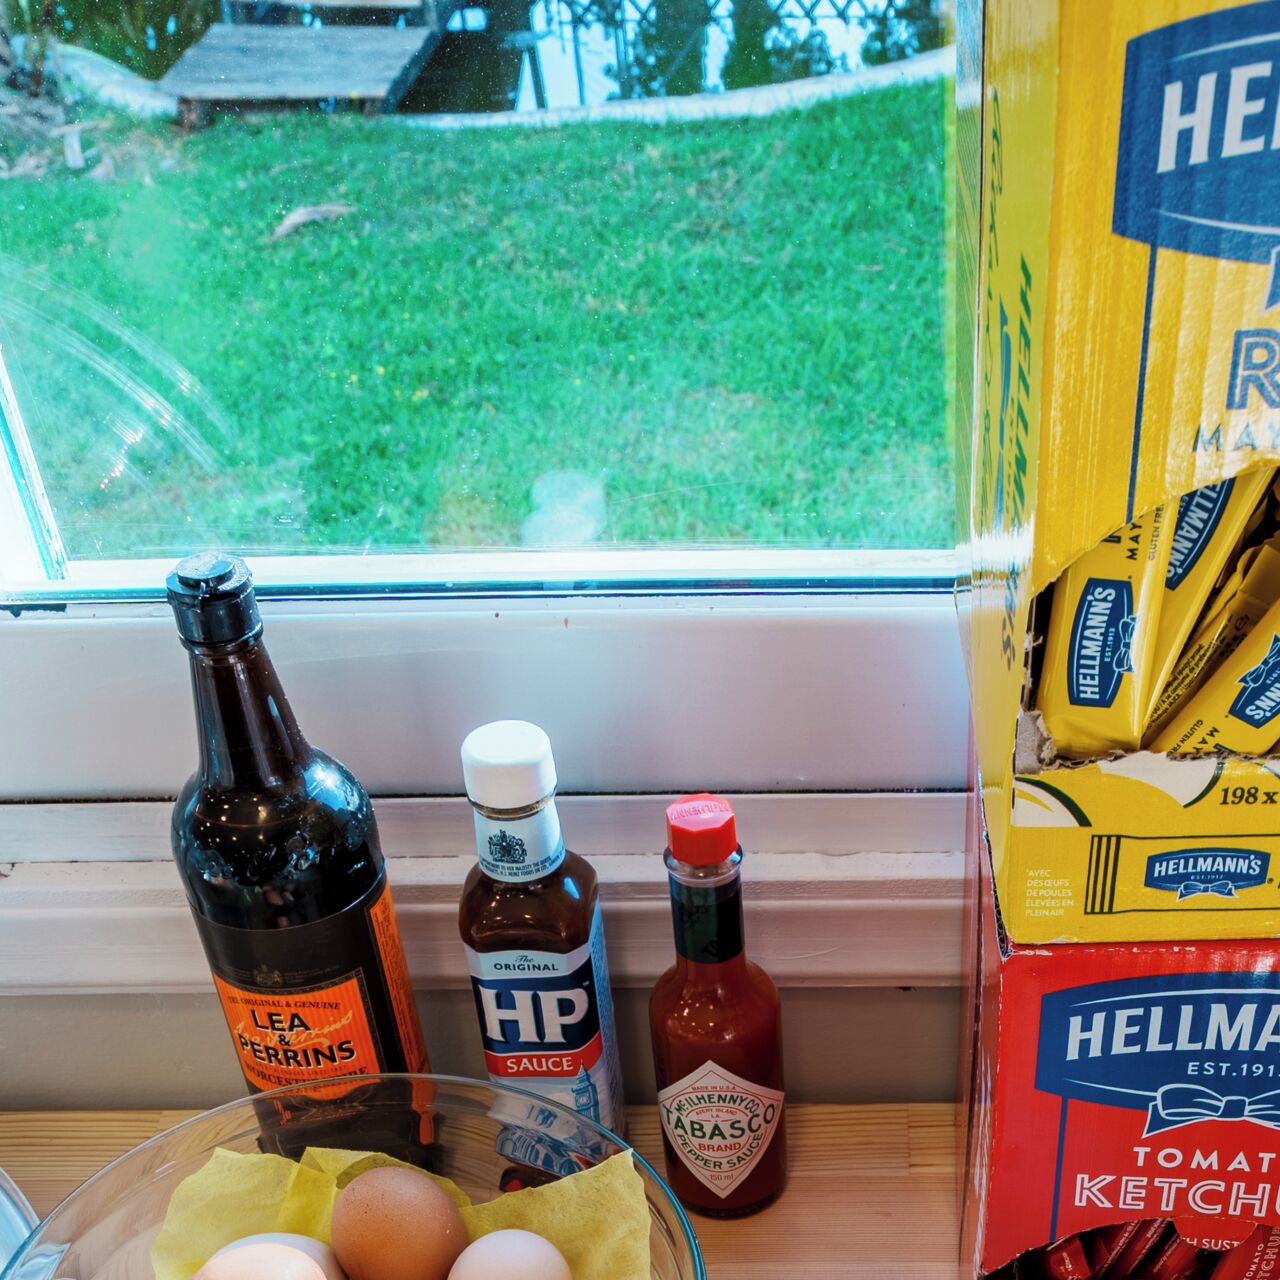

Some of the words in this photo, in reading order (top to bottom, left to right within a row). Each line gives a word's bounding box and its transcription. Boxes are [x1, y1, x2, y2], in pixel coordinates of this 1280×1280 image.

[1165, 481, 1220, 579] ELLMANN'S
[1078, 586, 1116, 700] HELLMANN'S
[1182, 719, 1204, 744] GLUTEN
[1220, 787, 1258, 805] 198
[1262, 791, 1278, 804] x
[1154, 854, 1262, 877] HELLMANN'S
[494, 963, 559, 972] ORIGINAL
[515, 955, 534, 963] The
[240, 998, 283, 1008] ORIGINAL
[294, 1001, 340, 1010] GENUINE
[478, 984, 589, 1043] HP
[251, 1009, 312, 1033] LEA
[278, 1034, 291, 1047] &
[238, 1040, 357, 1068] PERRINS
[506, 1057, 574, 1073] SAUCE
[662, 1103, 776, 1140] TABASCO
[677, 1133, 723, 1170] PEPPER
[726, 1133, 764, 1169] SAUCE
[698, 1142, 742, 1153] BRAND
[724, 1173, 734, 1181] ml
[1202, 1238, 1241, 1250] SUST
[1243, 1243, 1265, 1280] TOMATO
